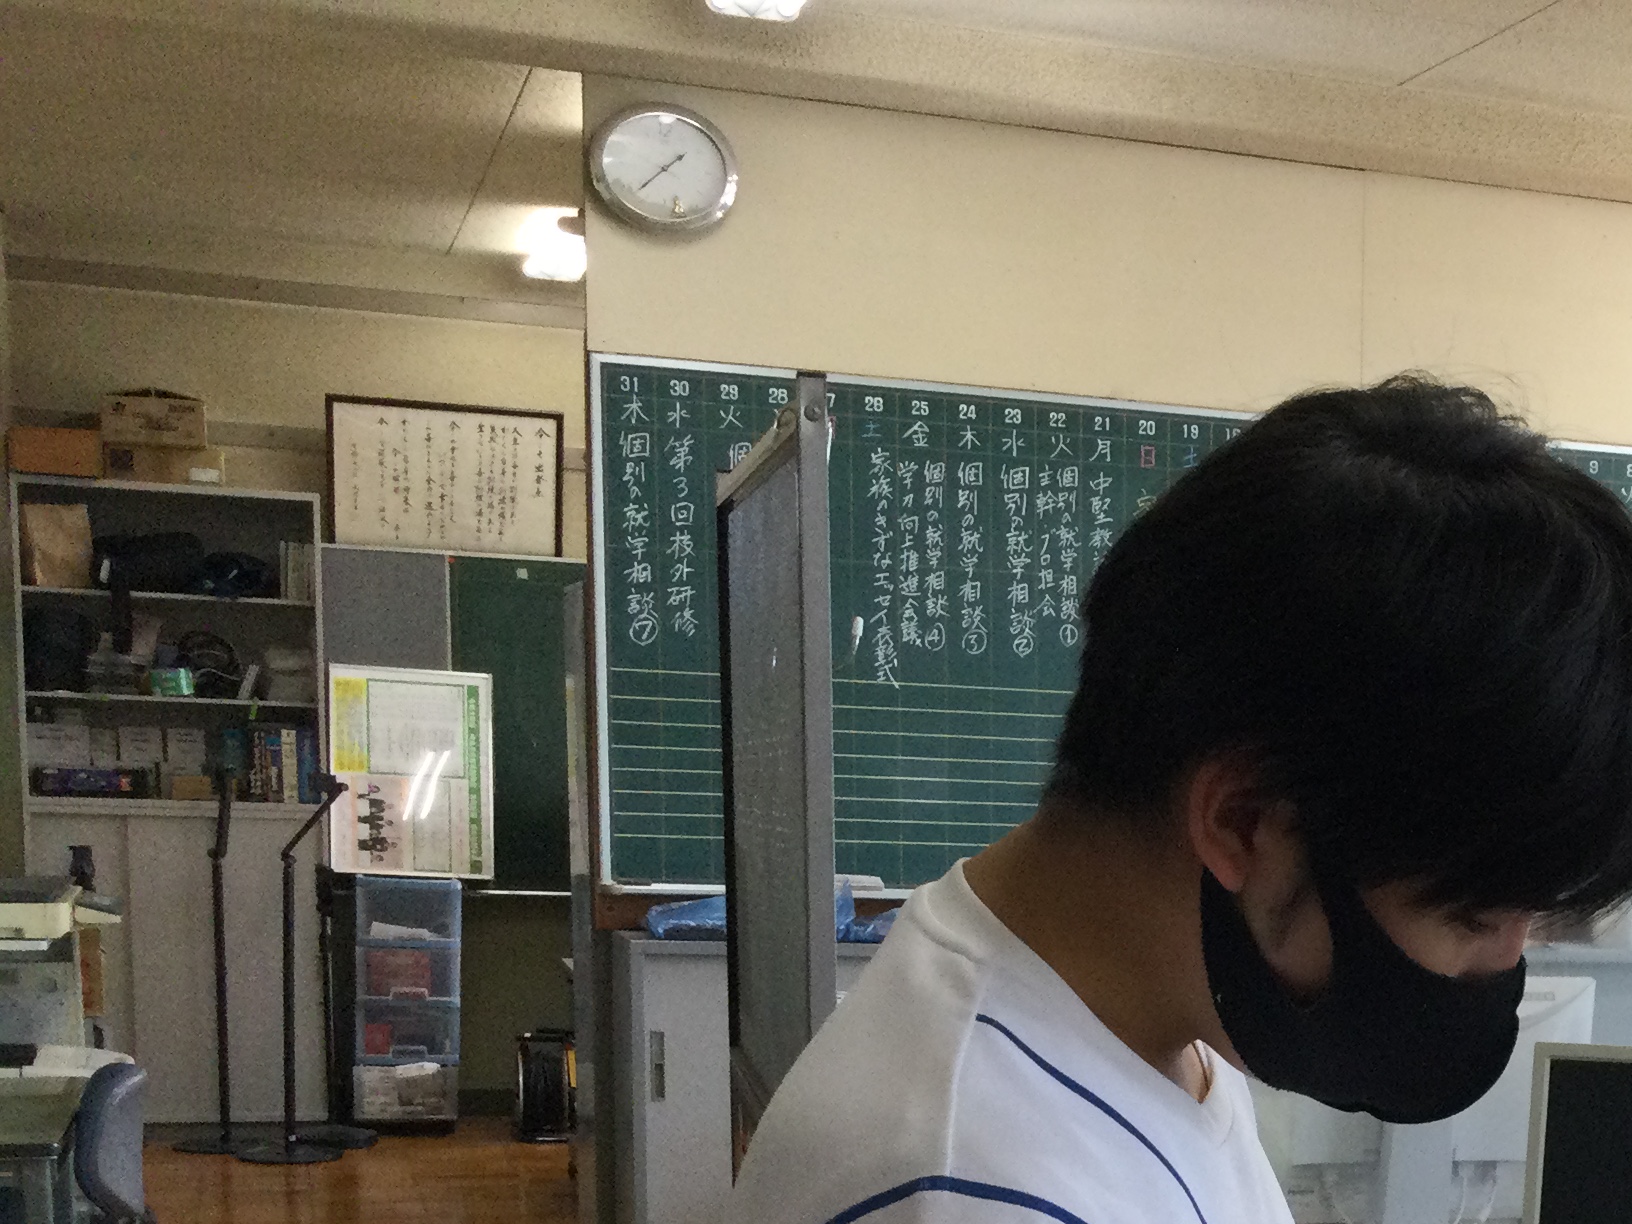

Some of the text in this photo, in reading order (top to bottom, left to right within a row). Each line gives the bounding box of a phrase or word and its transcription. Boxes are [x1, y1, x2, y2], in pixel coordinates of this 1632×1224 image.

[620, 376, 639, 393] 31
[670, 380, 690, 396] 30
[768, 387, 789, 404] 28
[621, 394, 649, 424] 木
[667, 401, 691, 428] 水
[719, 405, 743, 429] 火
[911, 401, 929, 416] 25
[959, 404, 976, 420] 24
[1004, 408, 1022, 424] 23
[1050, 412, 1066, 428] 22
[1094, 416, 1110, 431] 21
[1138, 420, 1156, 436] 20
[862, 420, 881, 438] 土
[902, 420, 930, 448] 金
[958, 425, 981, 450] 木
[1182, 424, 1199, 440] 19
[1002, 429, 1025, 457] 水
[1050, 434, 1073, 458] 火
[1089, 438, 1111, 462] 月
[1140, 445, 1156, 468] 日
[1589, 460, 1599, 474] 9
